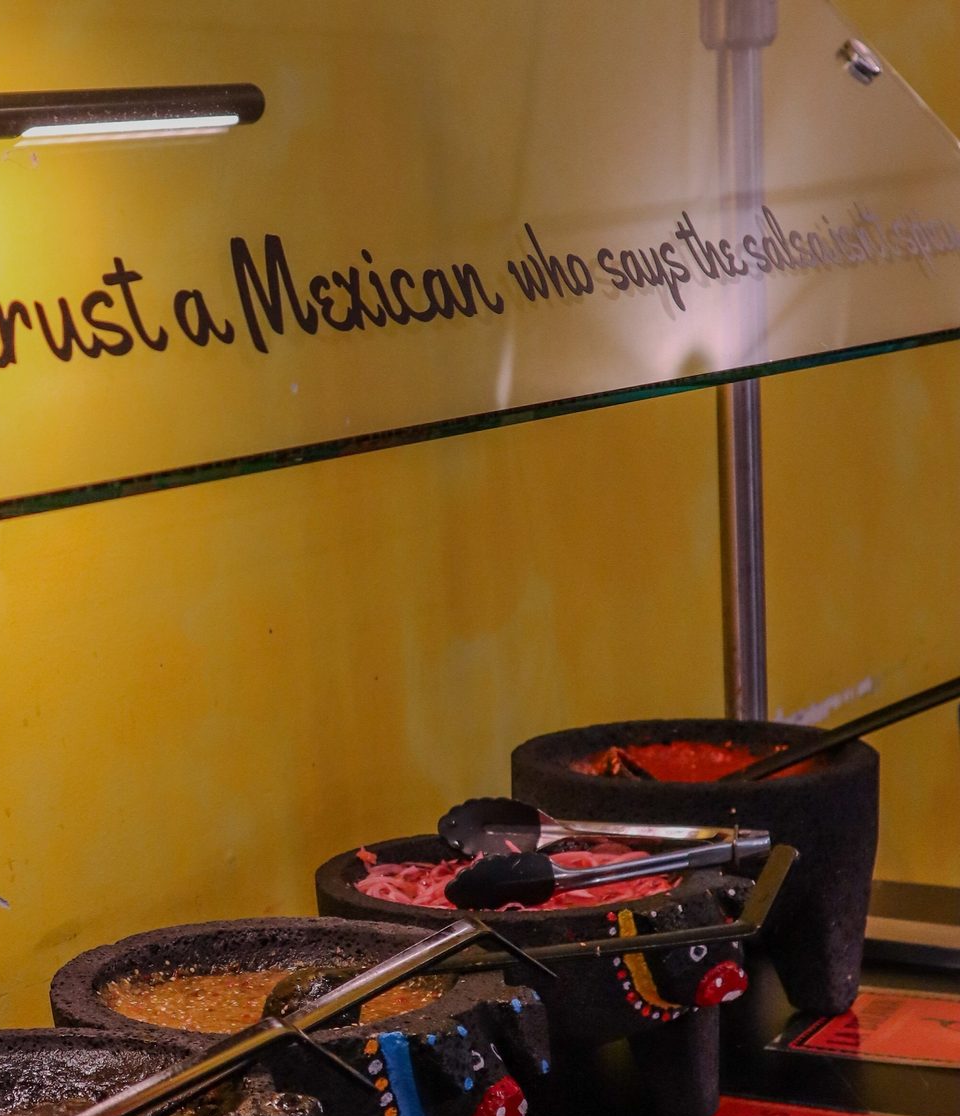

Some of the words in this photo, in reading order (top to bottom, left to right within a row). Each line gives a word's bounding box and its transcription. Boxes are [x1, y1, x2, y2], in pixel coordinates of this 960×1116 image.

[174, 289, 235, 346] a
[231, 233, 504, 354] Mexican
[508, 222, 592, 302] who
[602, 244, 689, 311] says
[675, 210, 748, 279] the
[743, 205, 830, 273] salsa
